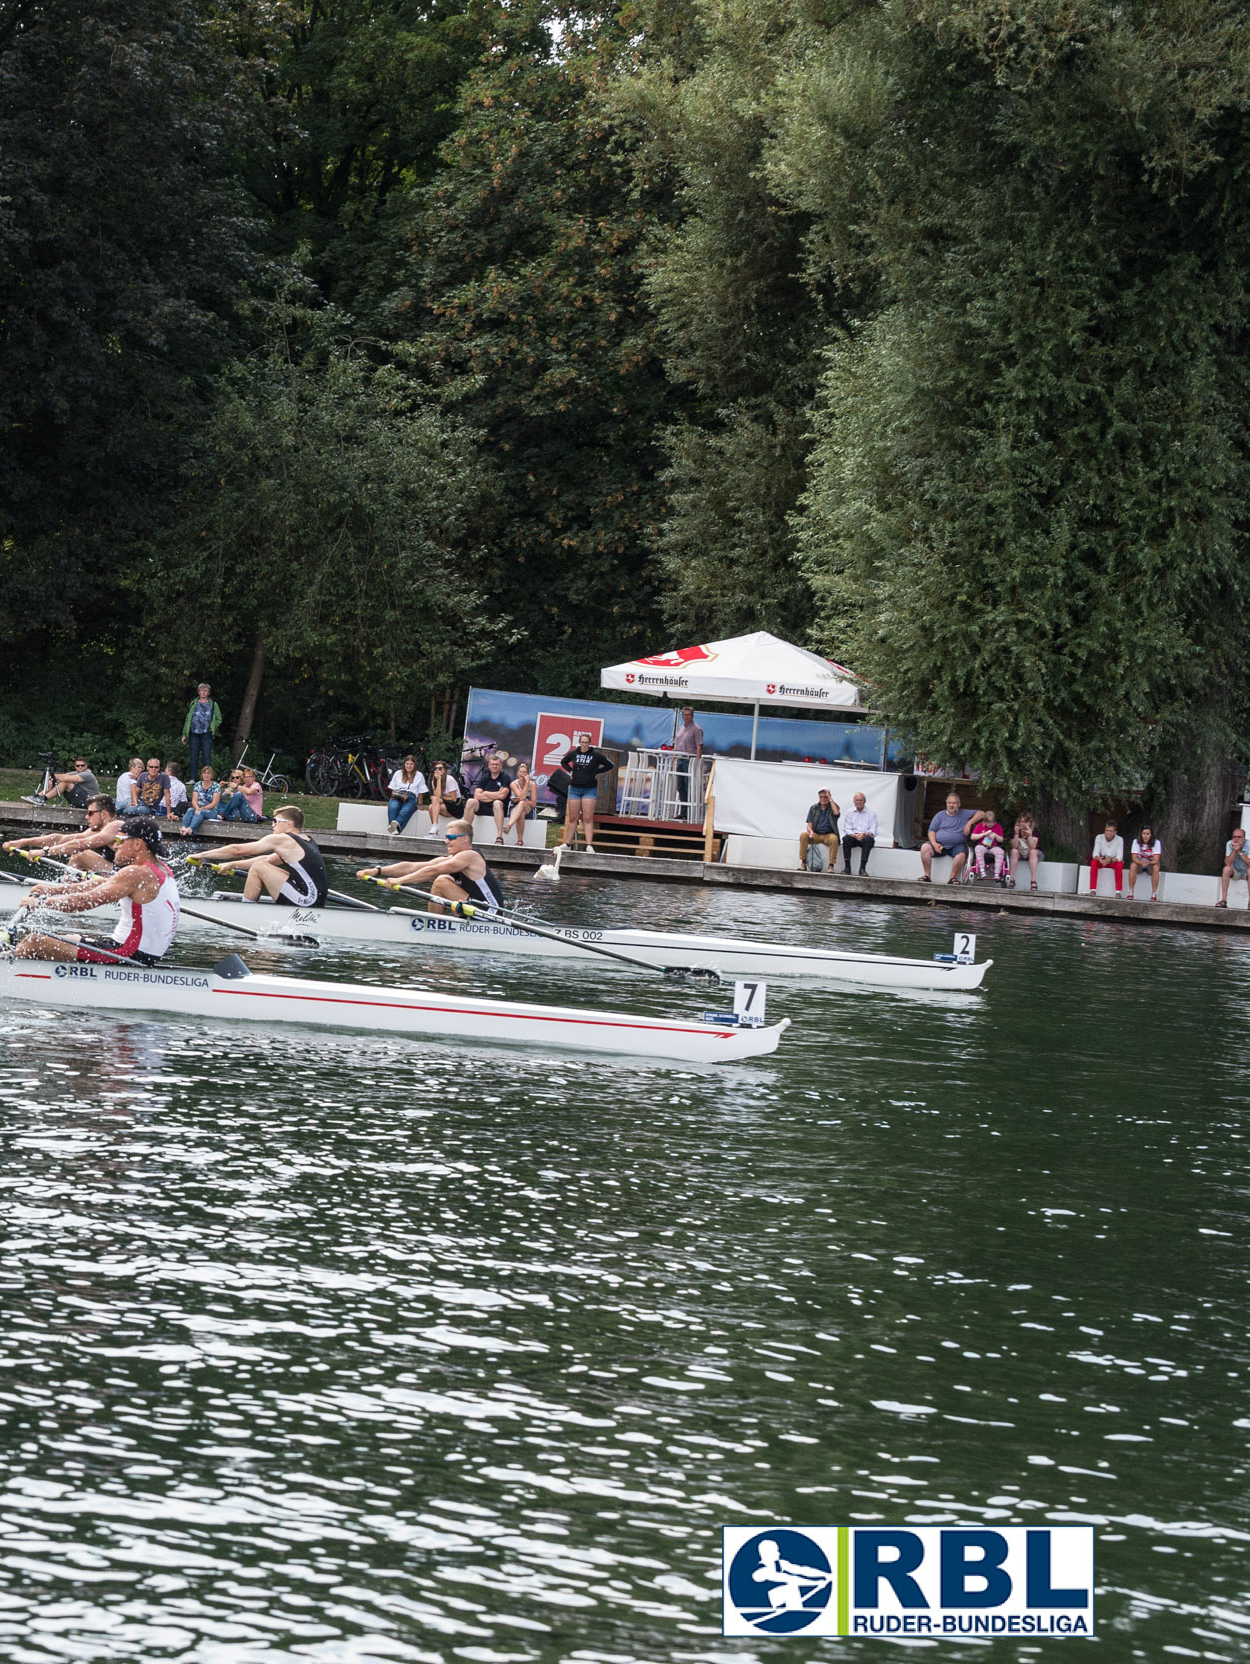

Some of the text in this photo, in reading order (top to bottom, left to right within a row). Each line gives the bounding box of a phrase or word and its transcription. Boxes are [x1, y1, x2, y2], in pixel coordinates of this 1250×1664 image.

[427, 919, 456, 931] RBL
[565, 929, 579, 939] BS
[582, 931, 603, 940] 002
[959, 935, 970, 955] 2
[69, 966, 209, 987] RBL RUDER-BUNDESLIGA
[743, 983, 758, 1012] 7
